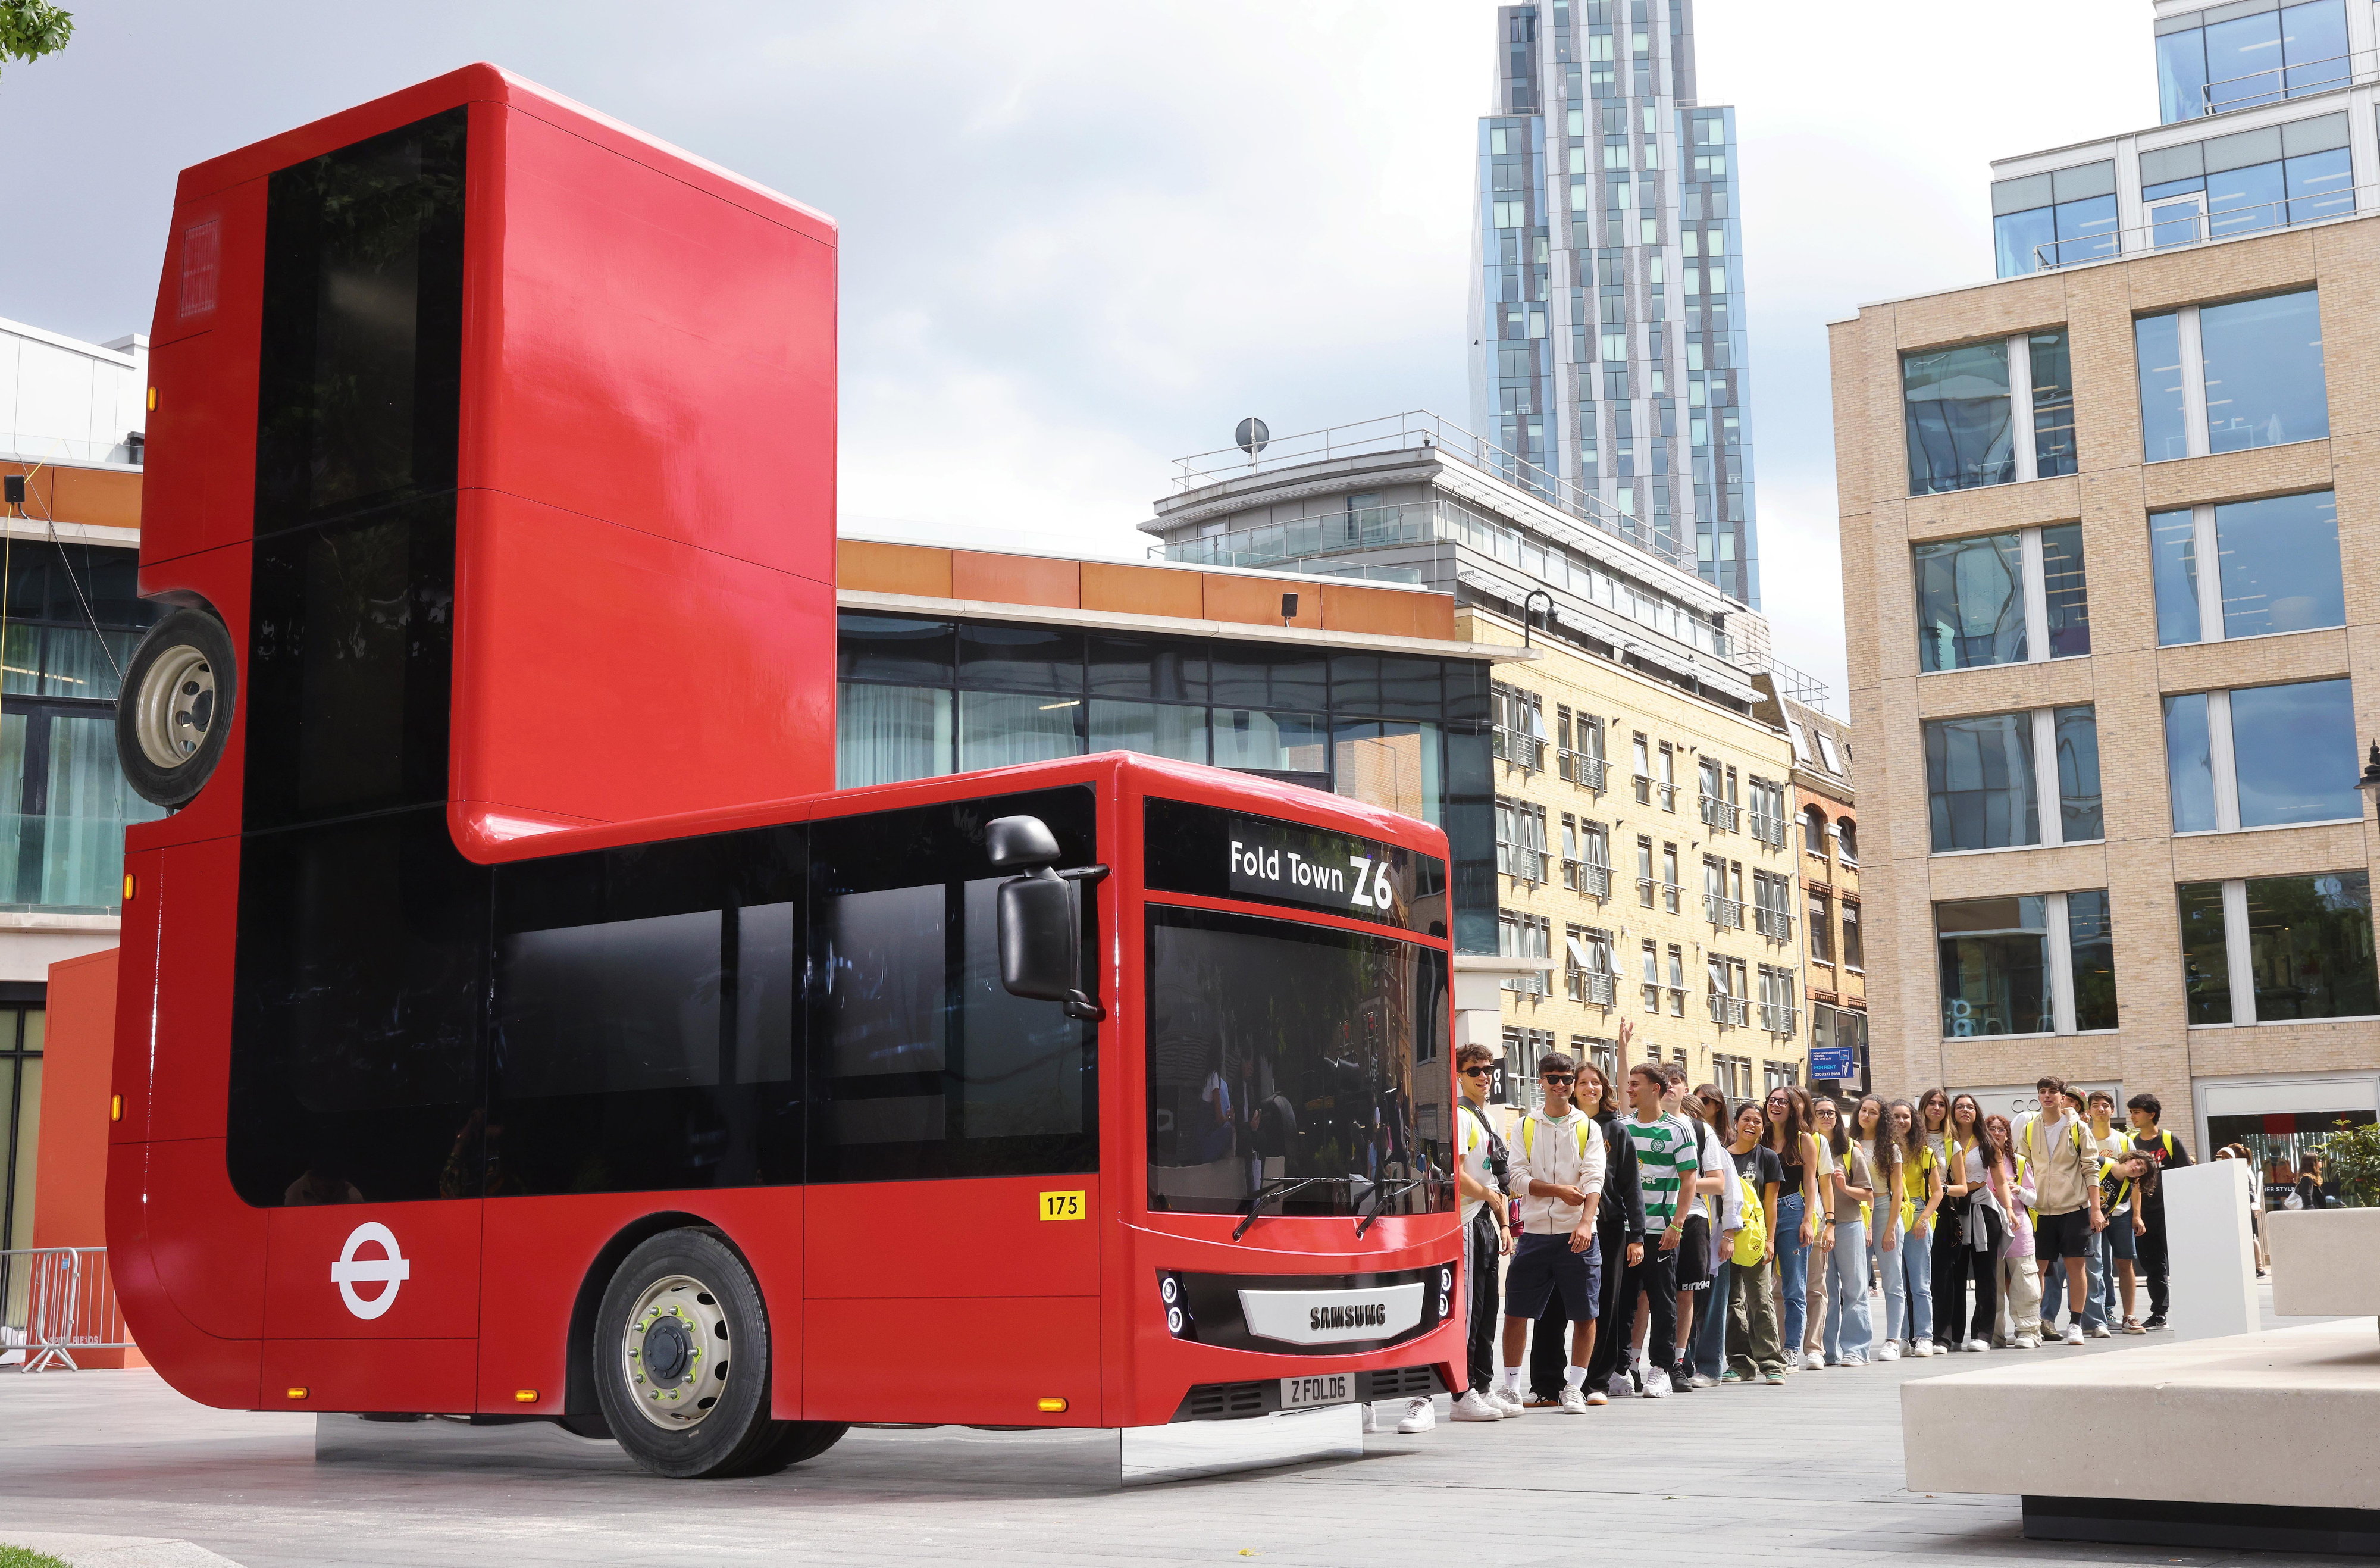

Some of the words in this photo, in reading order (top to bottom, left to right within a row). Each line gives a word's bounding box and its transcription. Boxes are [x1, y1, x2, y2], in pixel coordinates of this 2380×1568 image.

[1231, 841, 1279, 881] Fold
[1288, 852, 1344, 893] Town
[1350, 855, 1392, 910] Z6
[1047, 1196, 1078, 1215] 175
[1310, 1303, 1386, 1329] SAMSUNG
[1292, 1380, 1300, 1403] Z
[1304, 1376, 1345, 1401] FOLD6
